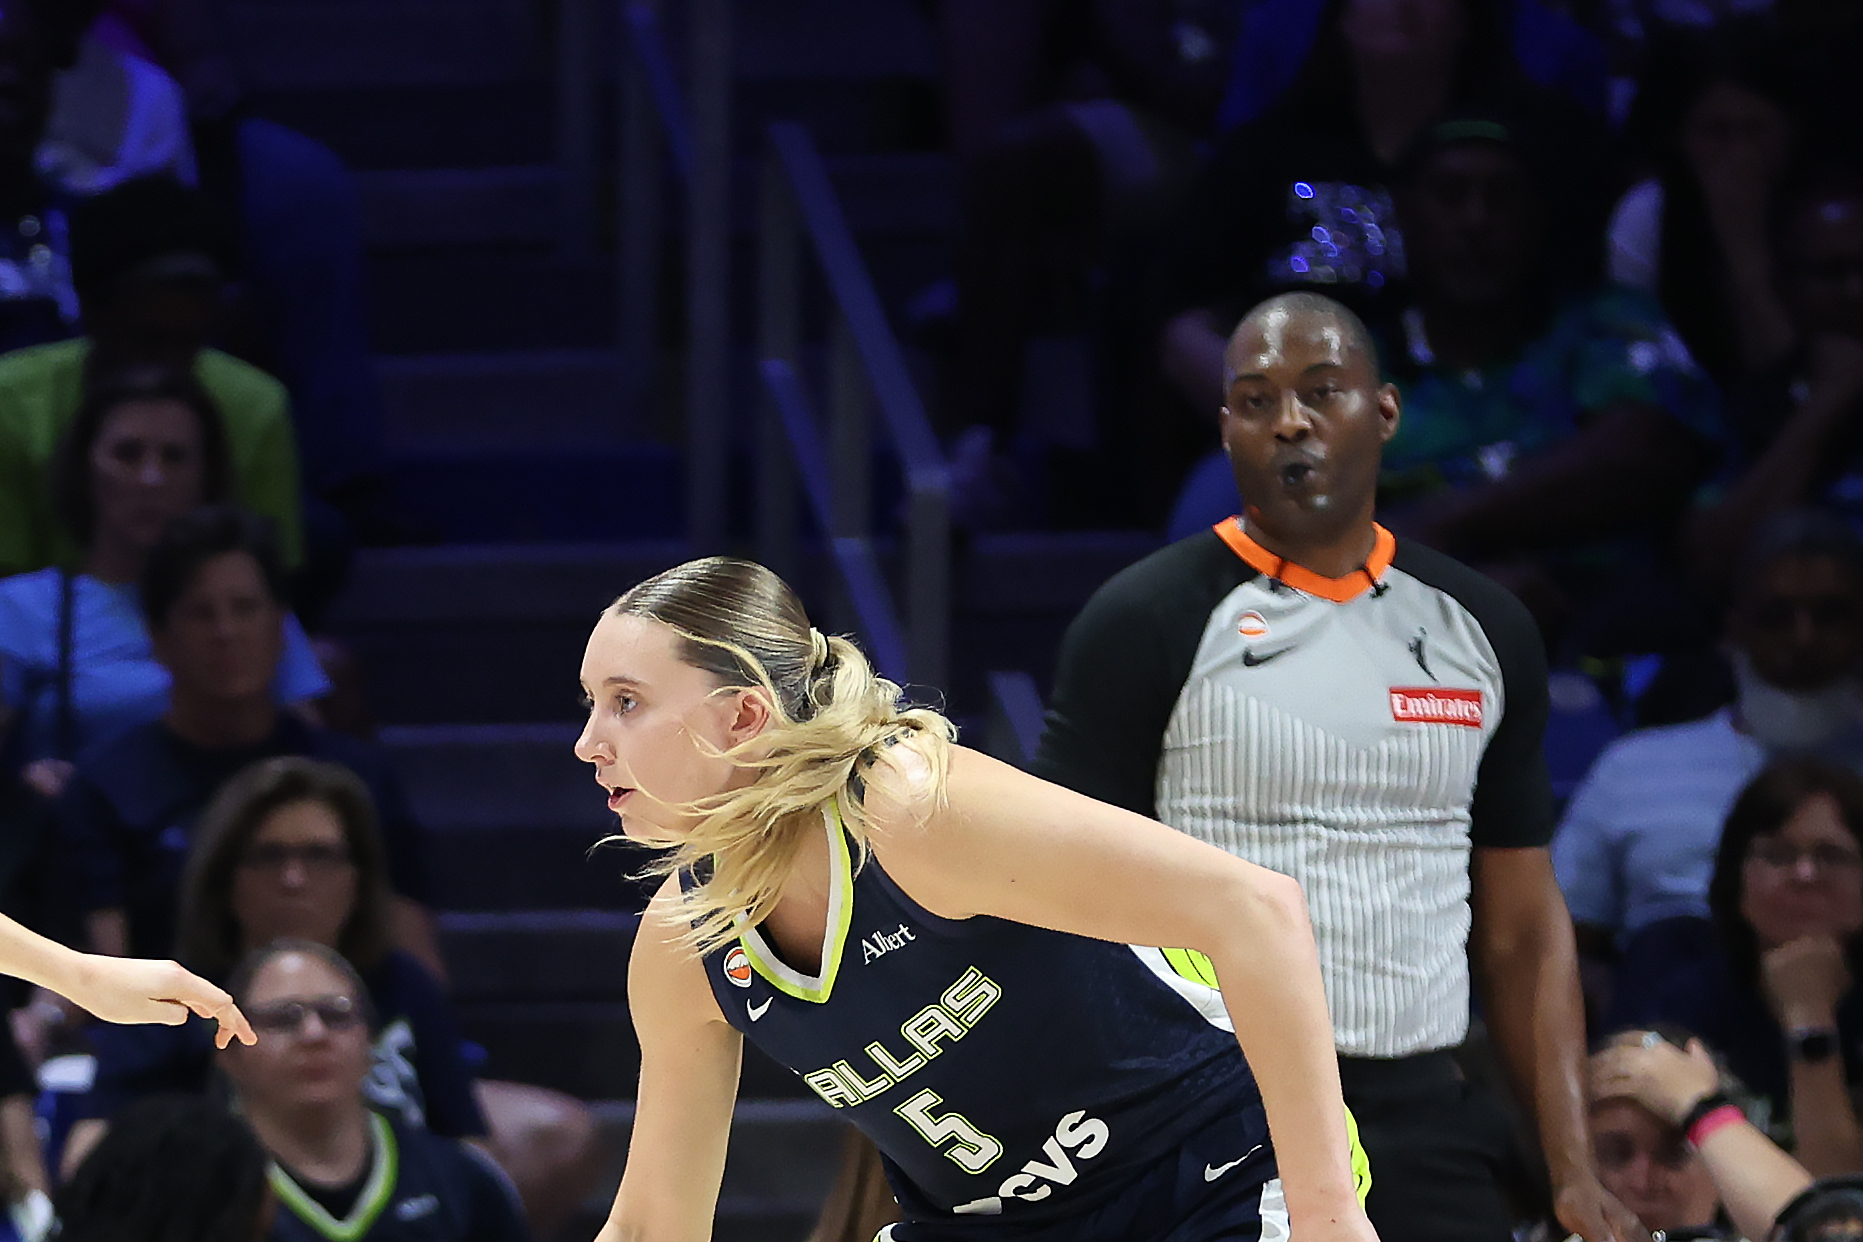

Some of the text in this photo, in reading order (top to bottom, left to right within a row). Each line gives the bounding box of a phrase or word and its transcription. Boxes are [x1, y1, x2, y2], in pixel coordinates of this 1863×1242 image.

[861, 923, 917, 966] Albert
[788, 965, 1003, 1109] ALLAS
[892, 1086, 1004, 1175] 5
[998, 1109, 1110, 1202] CVS
